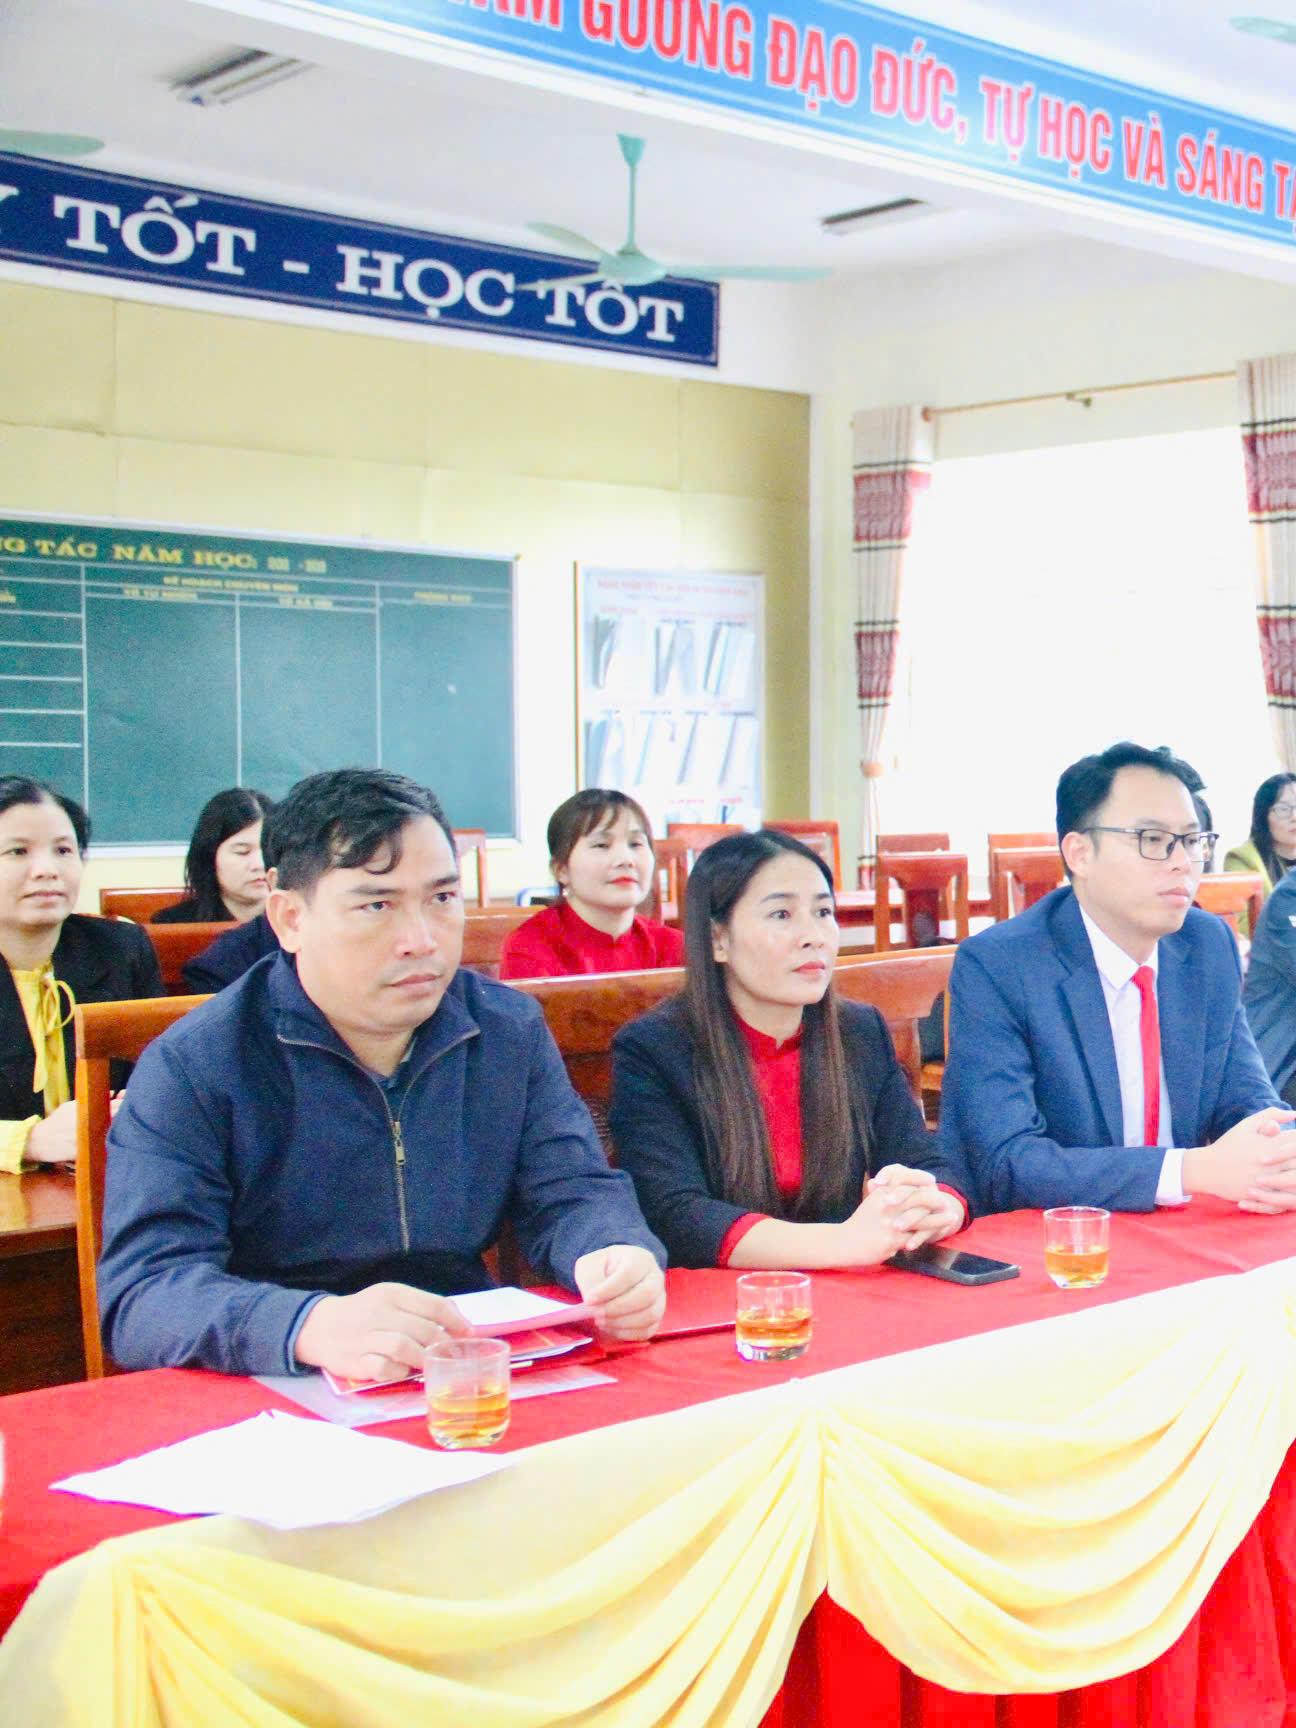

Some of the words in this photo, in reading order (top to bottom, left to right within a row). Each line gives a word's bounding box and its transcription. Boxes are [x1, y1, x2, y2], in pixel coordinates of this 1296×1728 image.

[768, 19, 857, 111] ĐẠO
[981, 78, 1033, 162] TỰ
[1039, 96, 1111, 178] HỌC
[1122, 113, 1167, 186] VÀ
[1176, 131, 1264, 212] SÁNG
[53, 193, 257, 276] TỐT
[336, 244, 516, 320] HỌC
[34, 536, 98, 558] TÁC
[112, 543, 184, 565] NĂM
